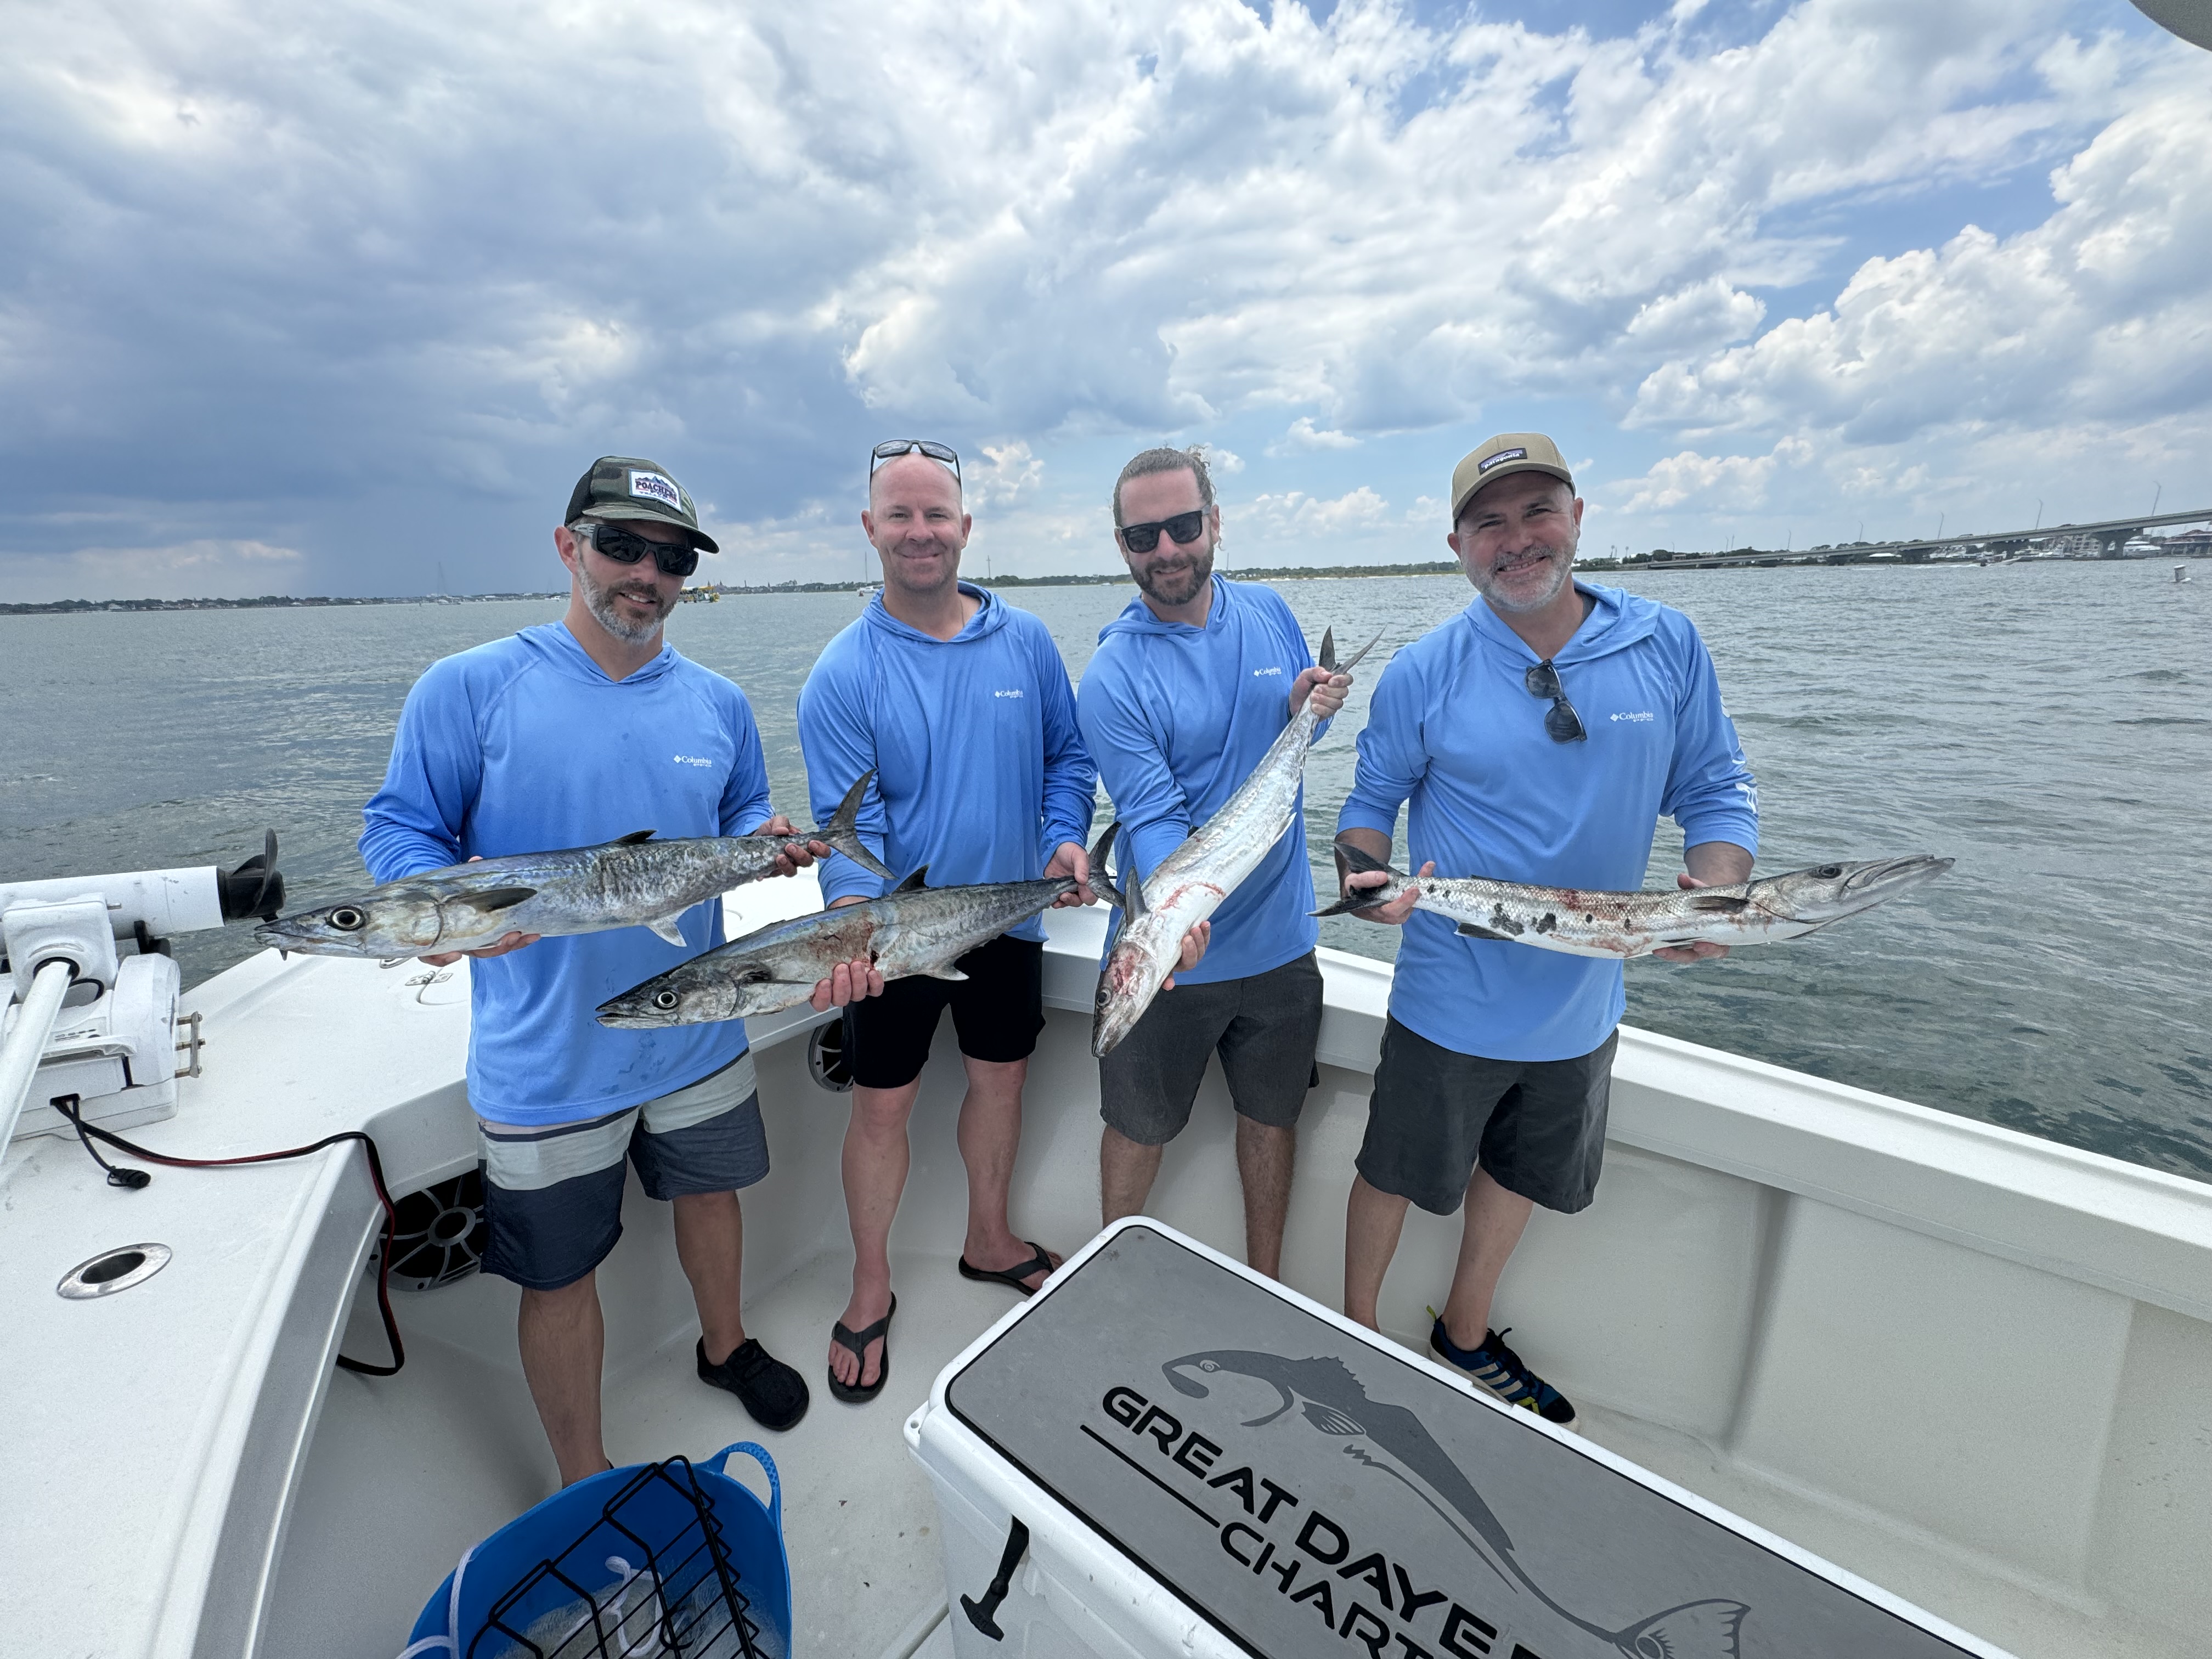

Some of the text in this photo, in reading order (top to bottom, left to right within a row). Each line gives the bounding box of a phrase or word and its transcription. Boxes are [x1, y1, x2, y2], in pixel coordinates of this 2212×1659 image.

[1485, 453, 1520, 469] patagonia
[635, 481, 678, 501] POACHERS
[1619, 711, 1653, 720] Columbia
[681, 755, 712, 764] Columbia
[1102, 1386, 1544, 1659] GREAT DAYE
